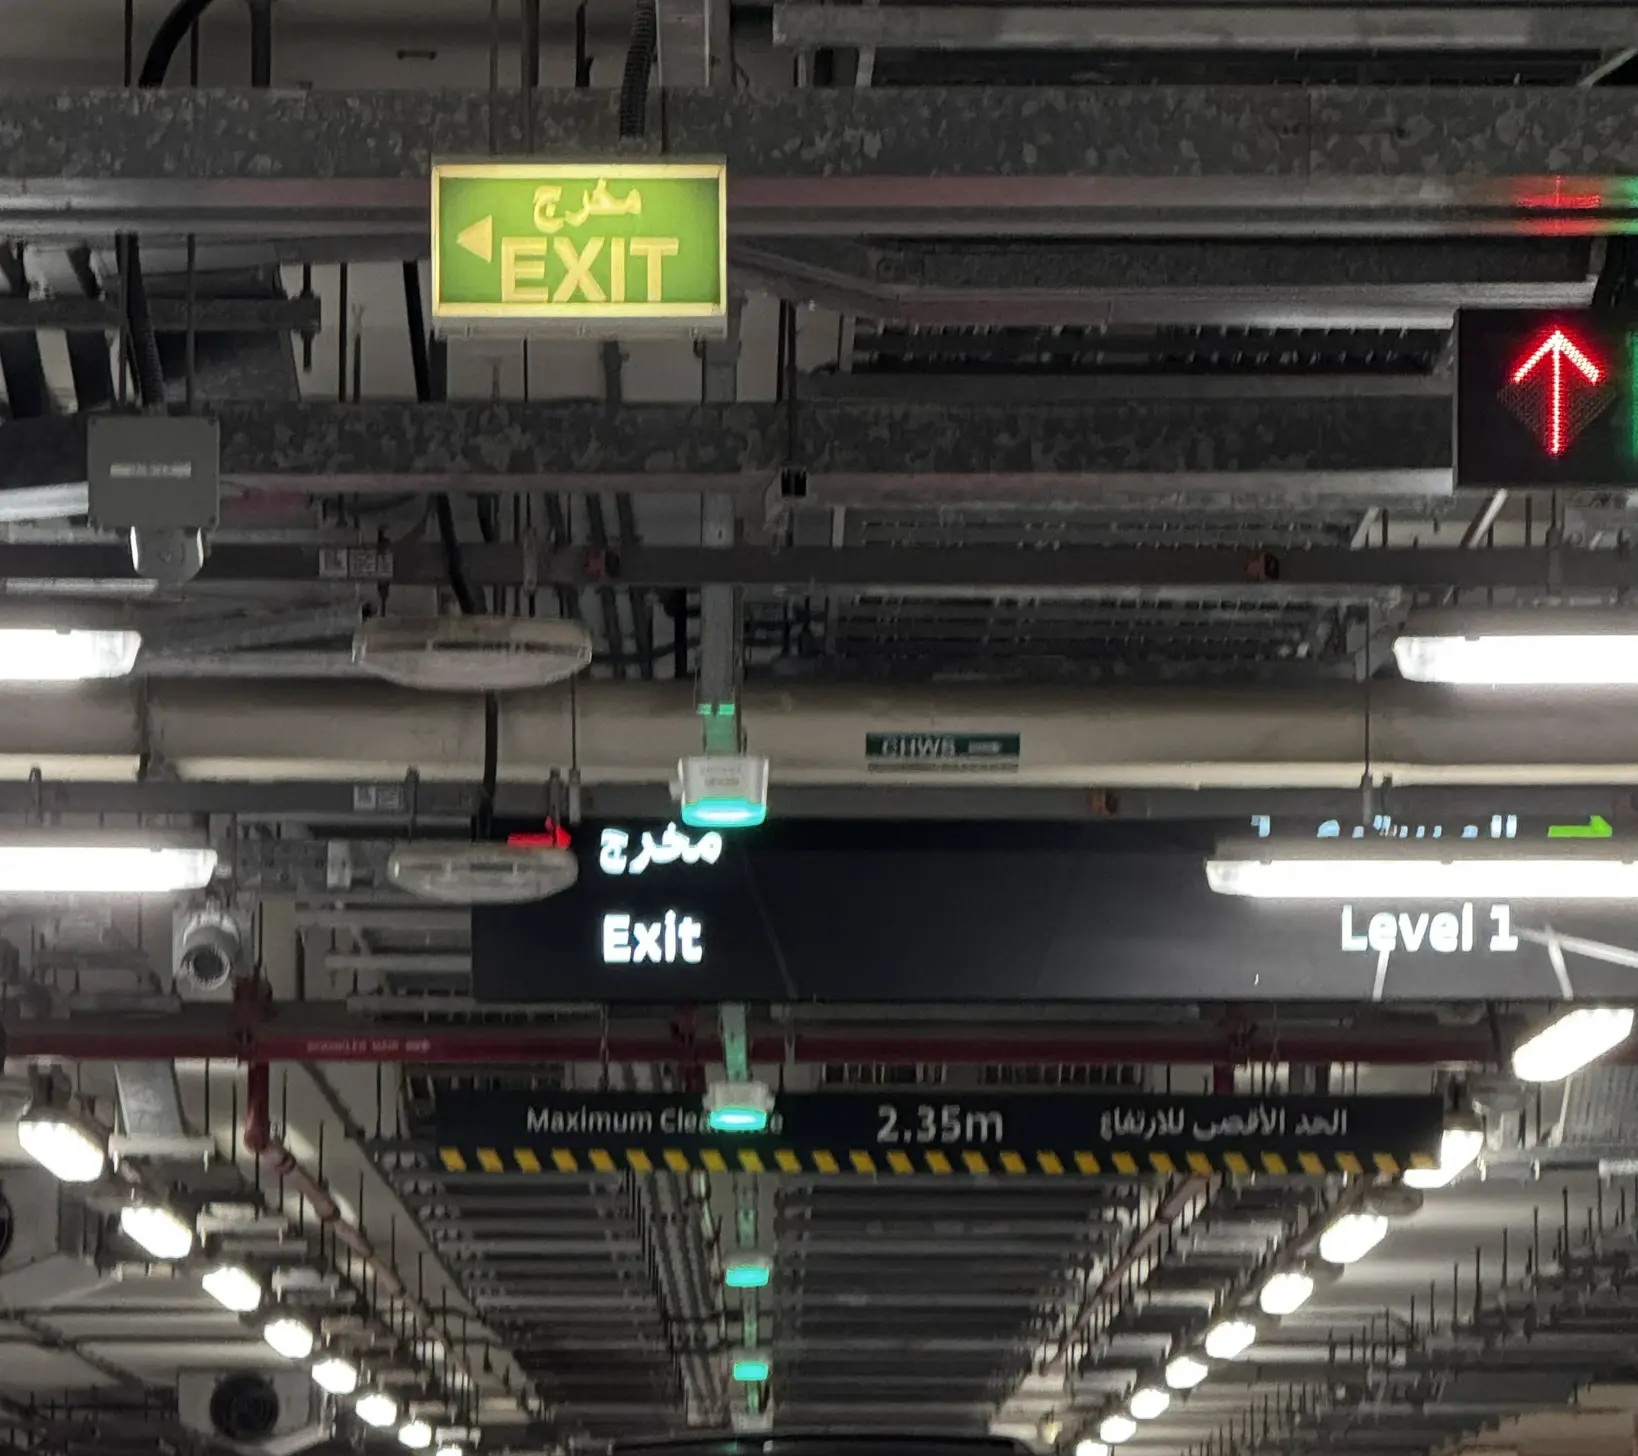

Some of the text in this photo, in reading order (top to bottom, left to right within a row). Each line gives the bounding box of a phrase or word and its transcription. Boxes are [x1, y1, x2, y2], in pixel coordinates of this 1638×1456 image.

[533, 176, 642, 233] مخرج
[501, 237, 679, 303] EXIT
[599, 821, 723, 875] مخرج
[603, 909, 703, 963] Exit
[1341, 902, 1519, 951] Level 1
[526, 1106, 653, 1133] Maximum
[877, 1104, 1004, 1143] 2.35m
[1193, 1104, 1286, 1141] الأقصى
[1295, 1108, 1348, 1136] الحد
